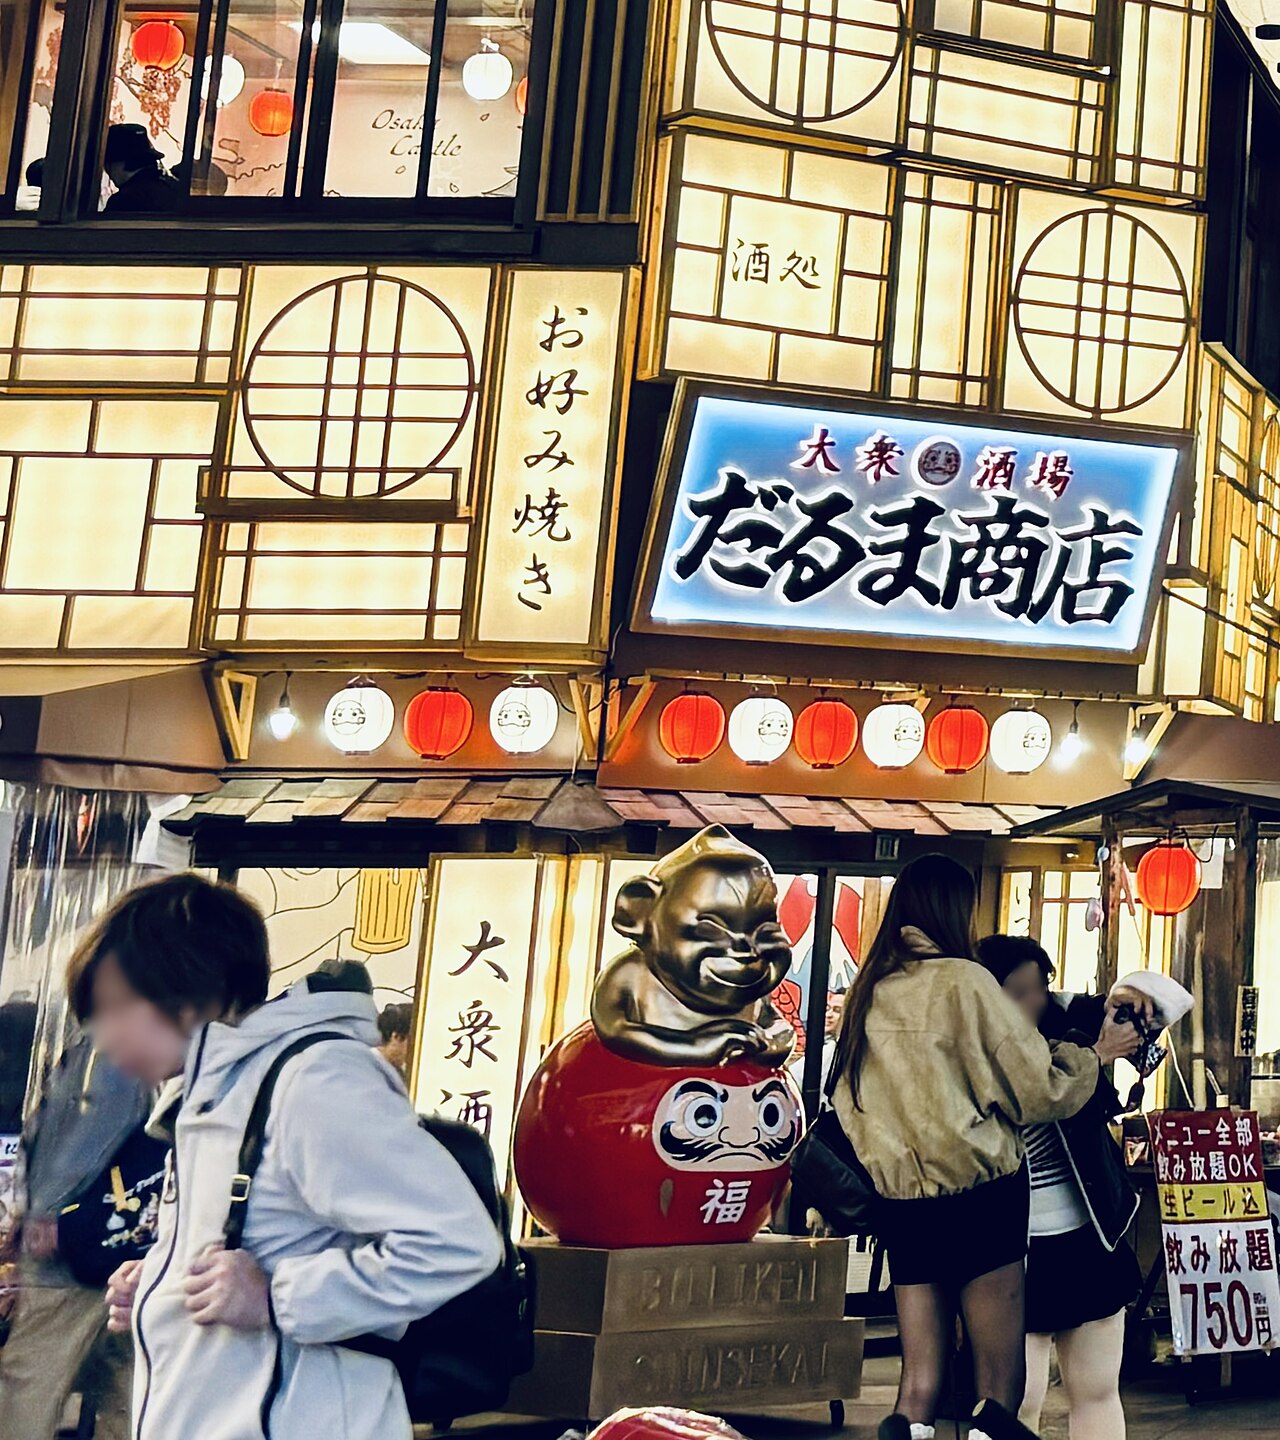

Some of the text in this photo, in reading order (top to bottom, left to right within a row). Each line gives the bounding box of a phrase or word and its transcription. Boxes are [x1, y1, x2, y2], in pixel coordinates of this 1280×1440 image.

[371, 108, 441, 131] Osa
[389, 133, 463, 157] Catle
[730, 237, 822, 290] 酒処
[512, 304, 589, 613] お好み焼き
[674, 468, 1145, 627] だるま商店
[1153, 1116, 1253, 1148] メニュー全部
[1156, 1150, 1259, 1183] 飲み放題OK
[699, 1178, 752, 1224] 福
[1164, 1186, 1261, 1218] 生ビール込
[1165, 1227, 1274, 1276] 飲み放題
[1179, 1279, 1254, 1351] 750
[1255, 1316, 1273, 1347] 円
